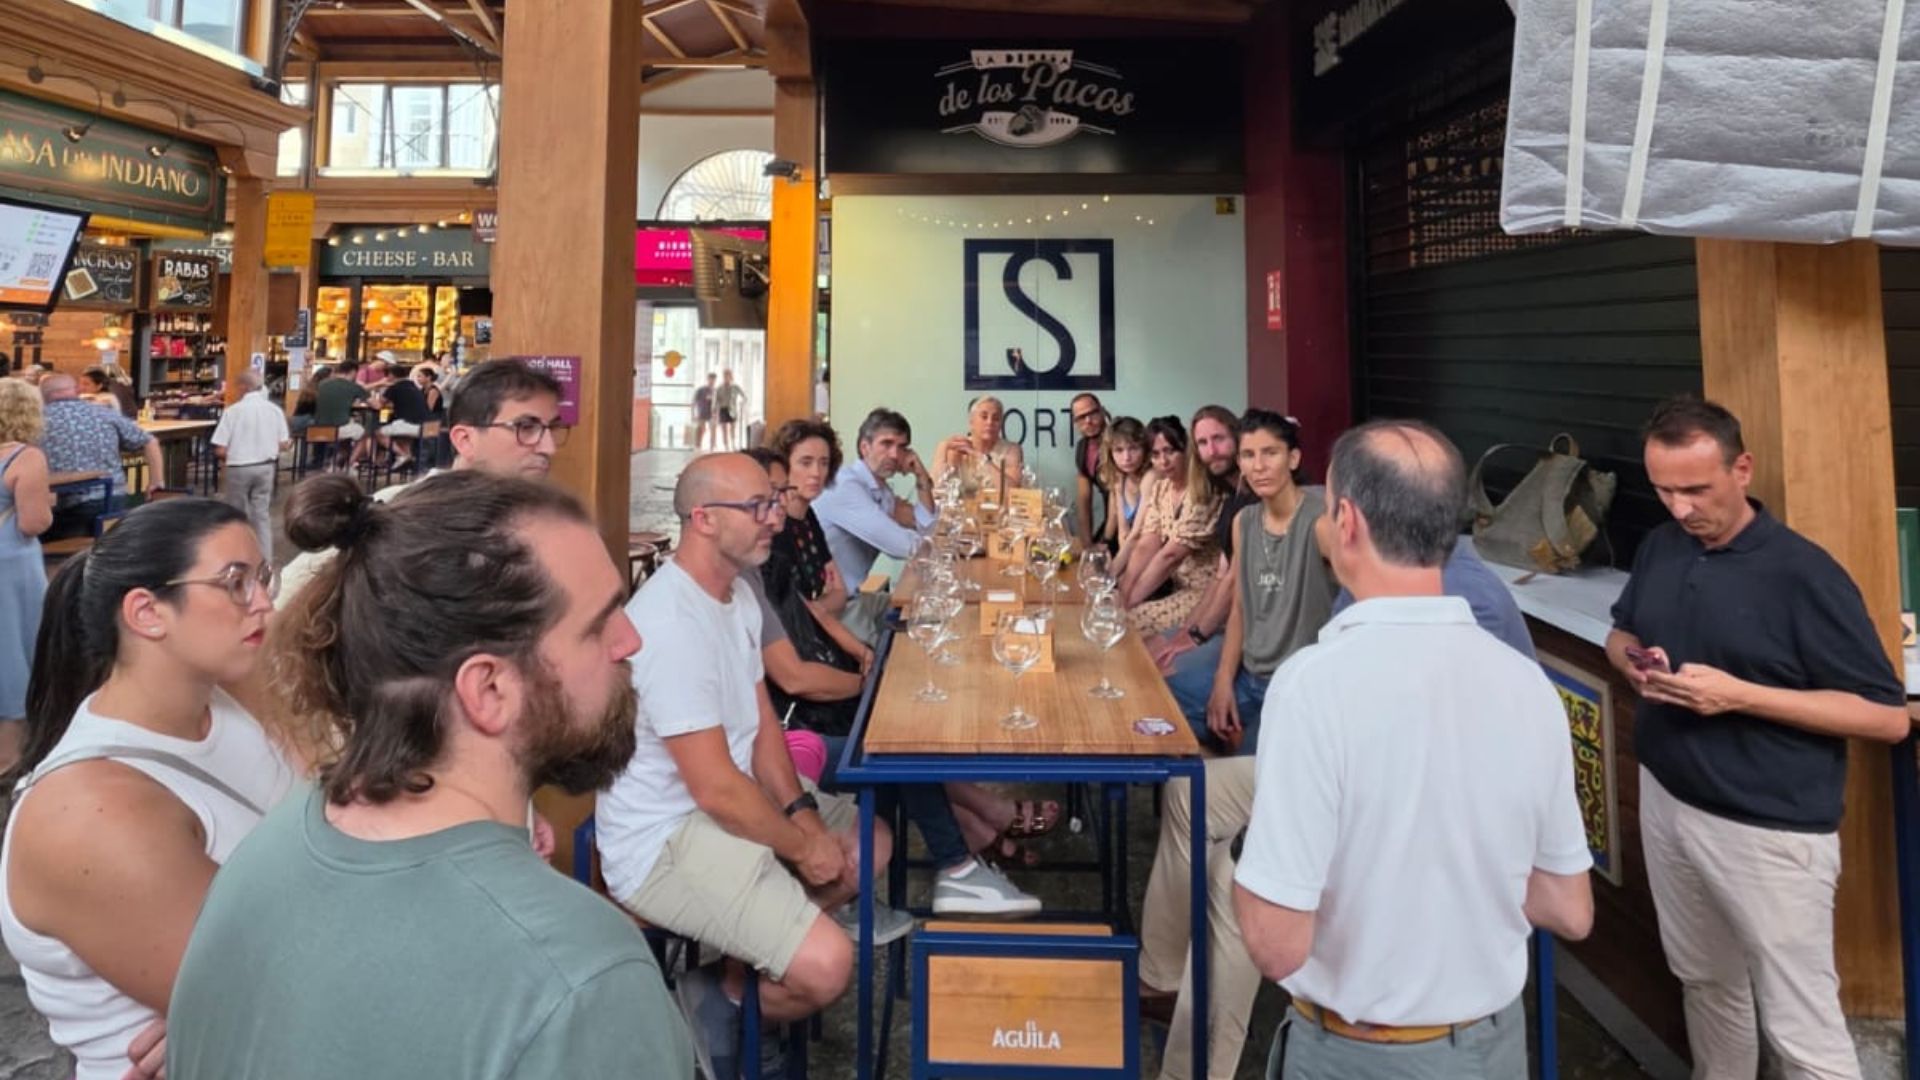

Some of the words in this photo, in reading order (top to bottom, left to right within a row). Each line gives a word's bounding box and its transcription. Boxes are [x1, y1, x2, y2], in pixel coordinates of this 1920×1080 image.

[939, 82, 972, 116] de
[977, 73, 1016, 105] los
[1020, 62, 1136, 116] Pacos
[0, 127, 57, 168] ASA
[102, 152, 201, 197] INDIANO
[164, 259, 209, 278] RABAS
[342, 250, 417, 267] CHEESE
[432, 251, 474, 267] BAR
[1001, 407, 1076, 448] ORT
